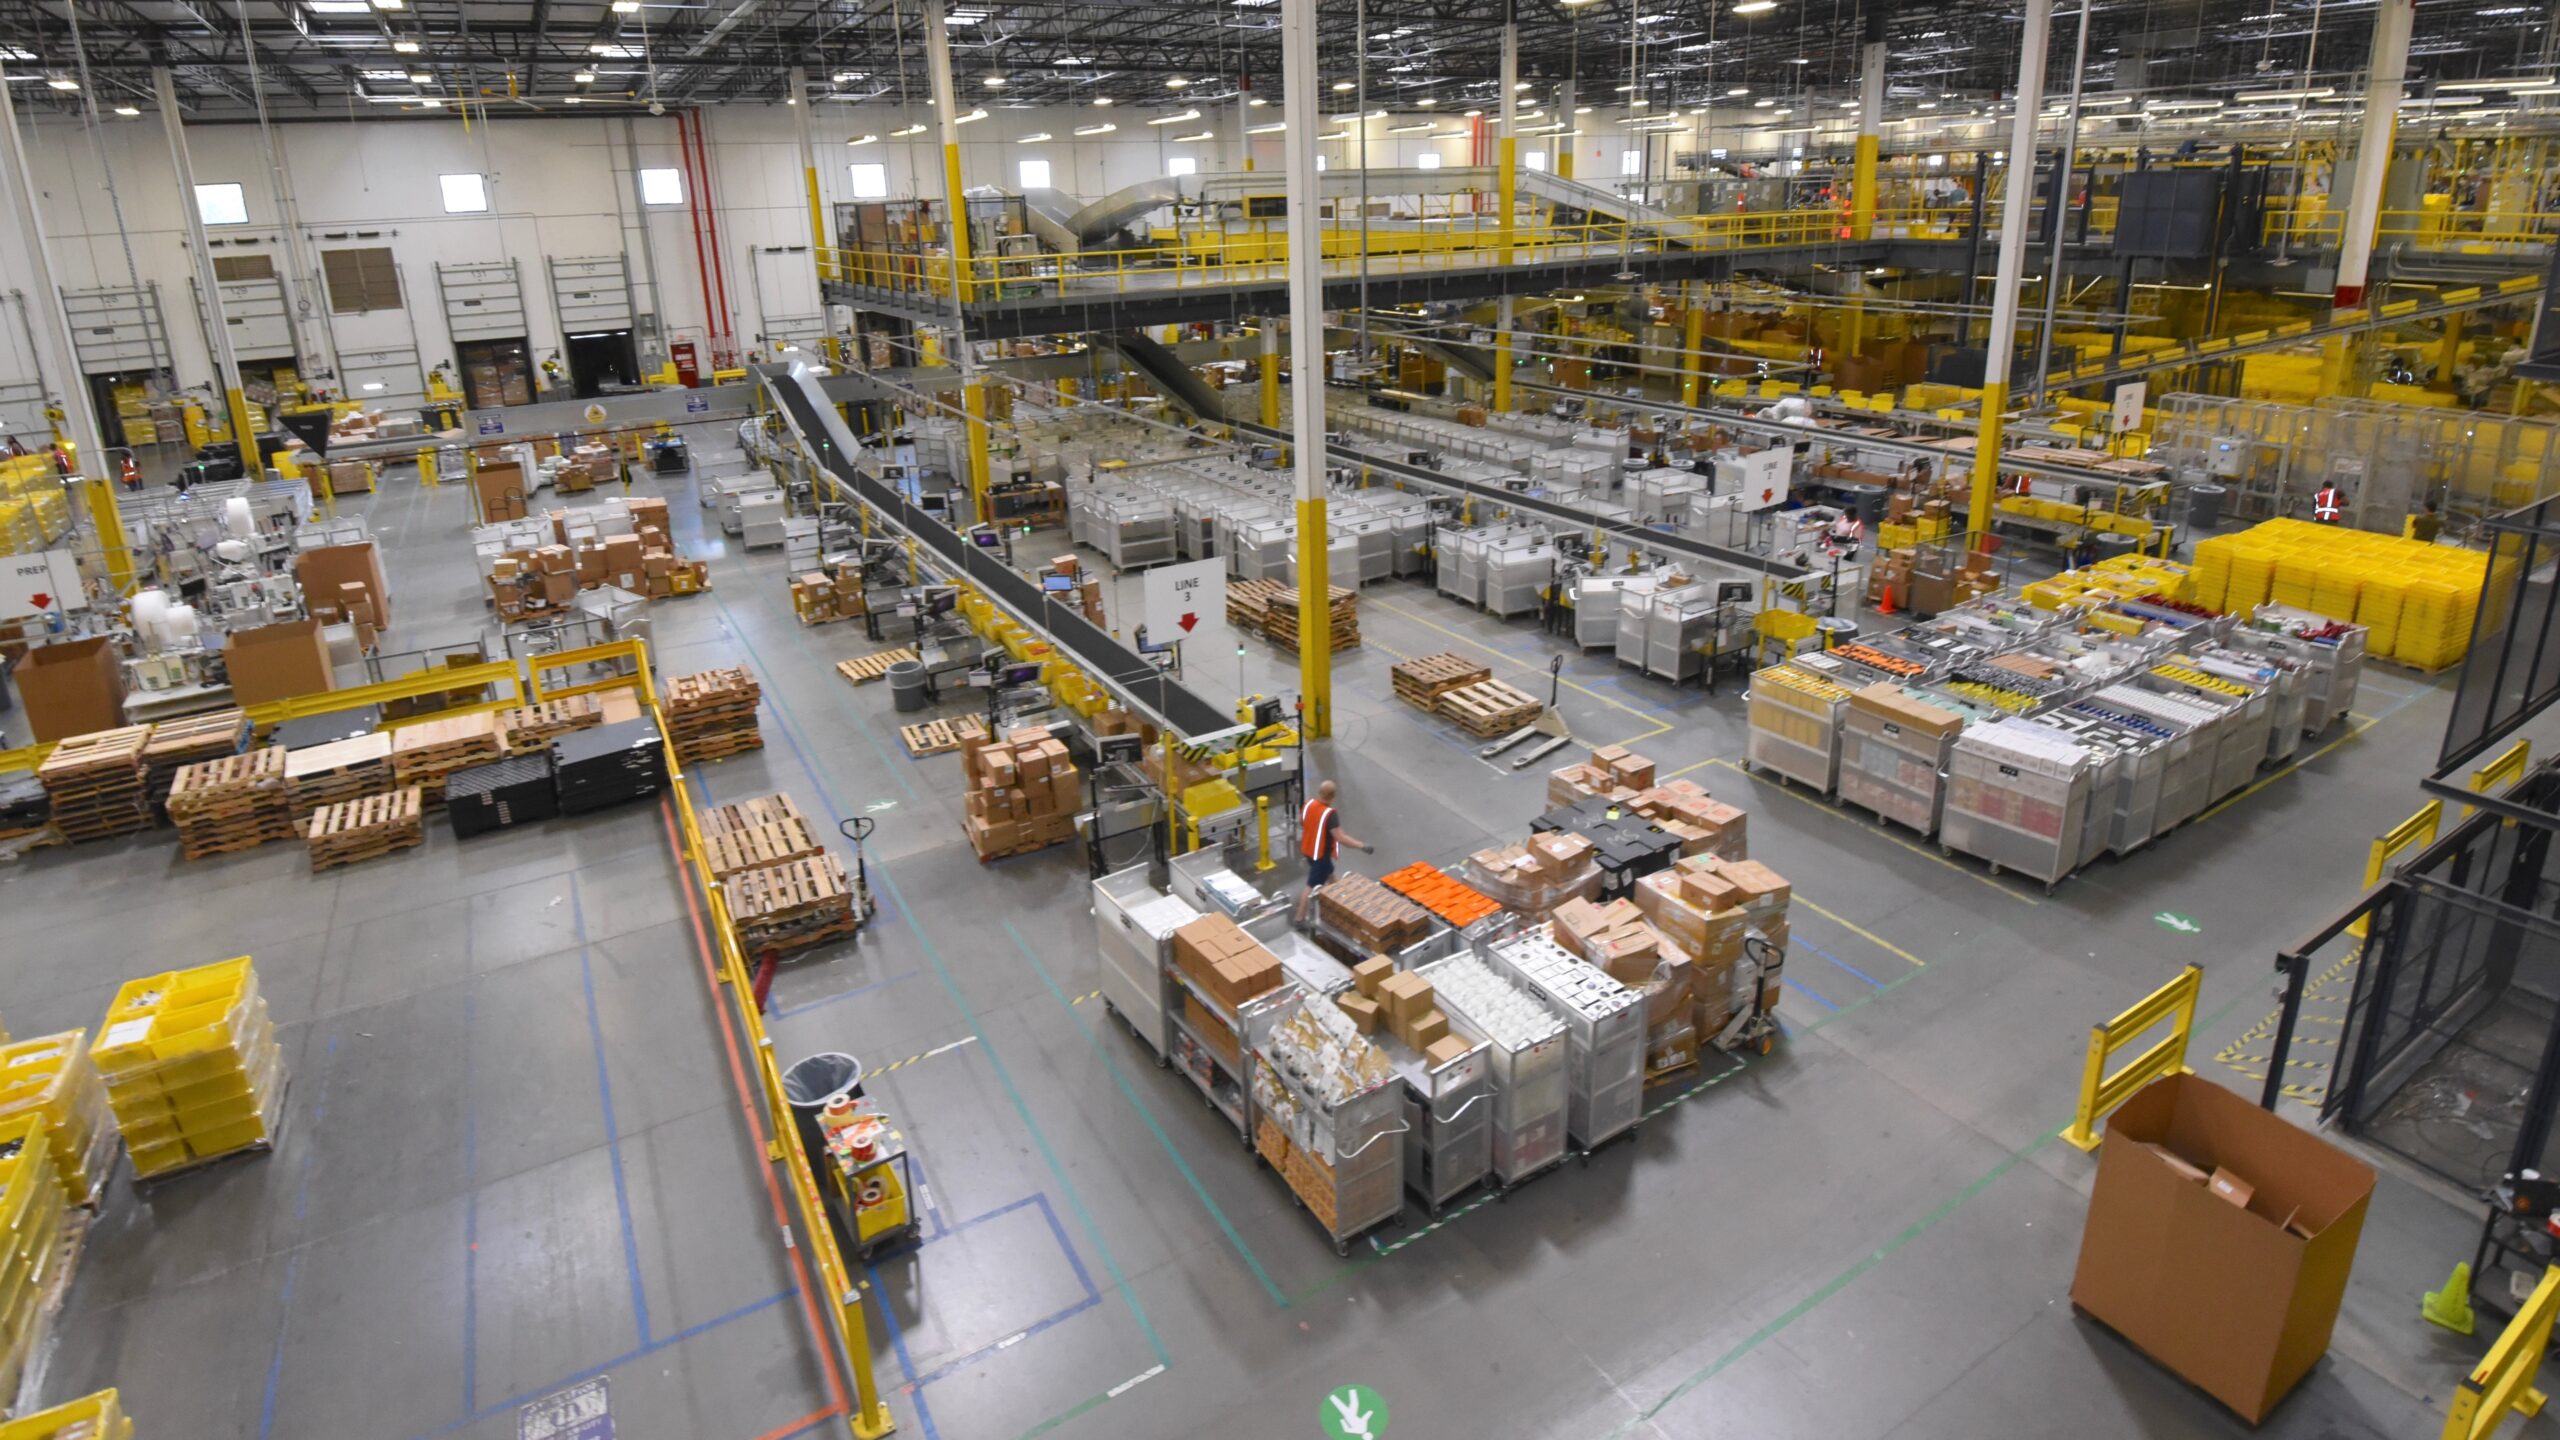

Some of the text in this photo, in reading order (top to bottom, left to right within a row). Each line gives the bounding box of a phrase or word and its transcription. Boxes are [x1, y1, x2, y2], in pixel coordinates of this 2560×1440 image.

[16, 564, 49, 576] PREP
[1175, 577, 1200, 591] LINE
[1184, 591, 1191, 602] 3
